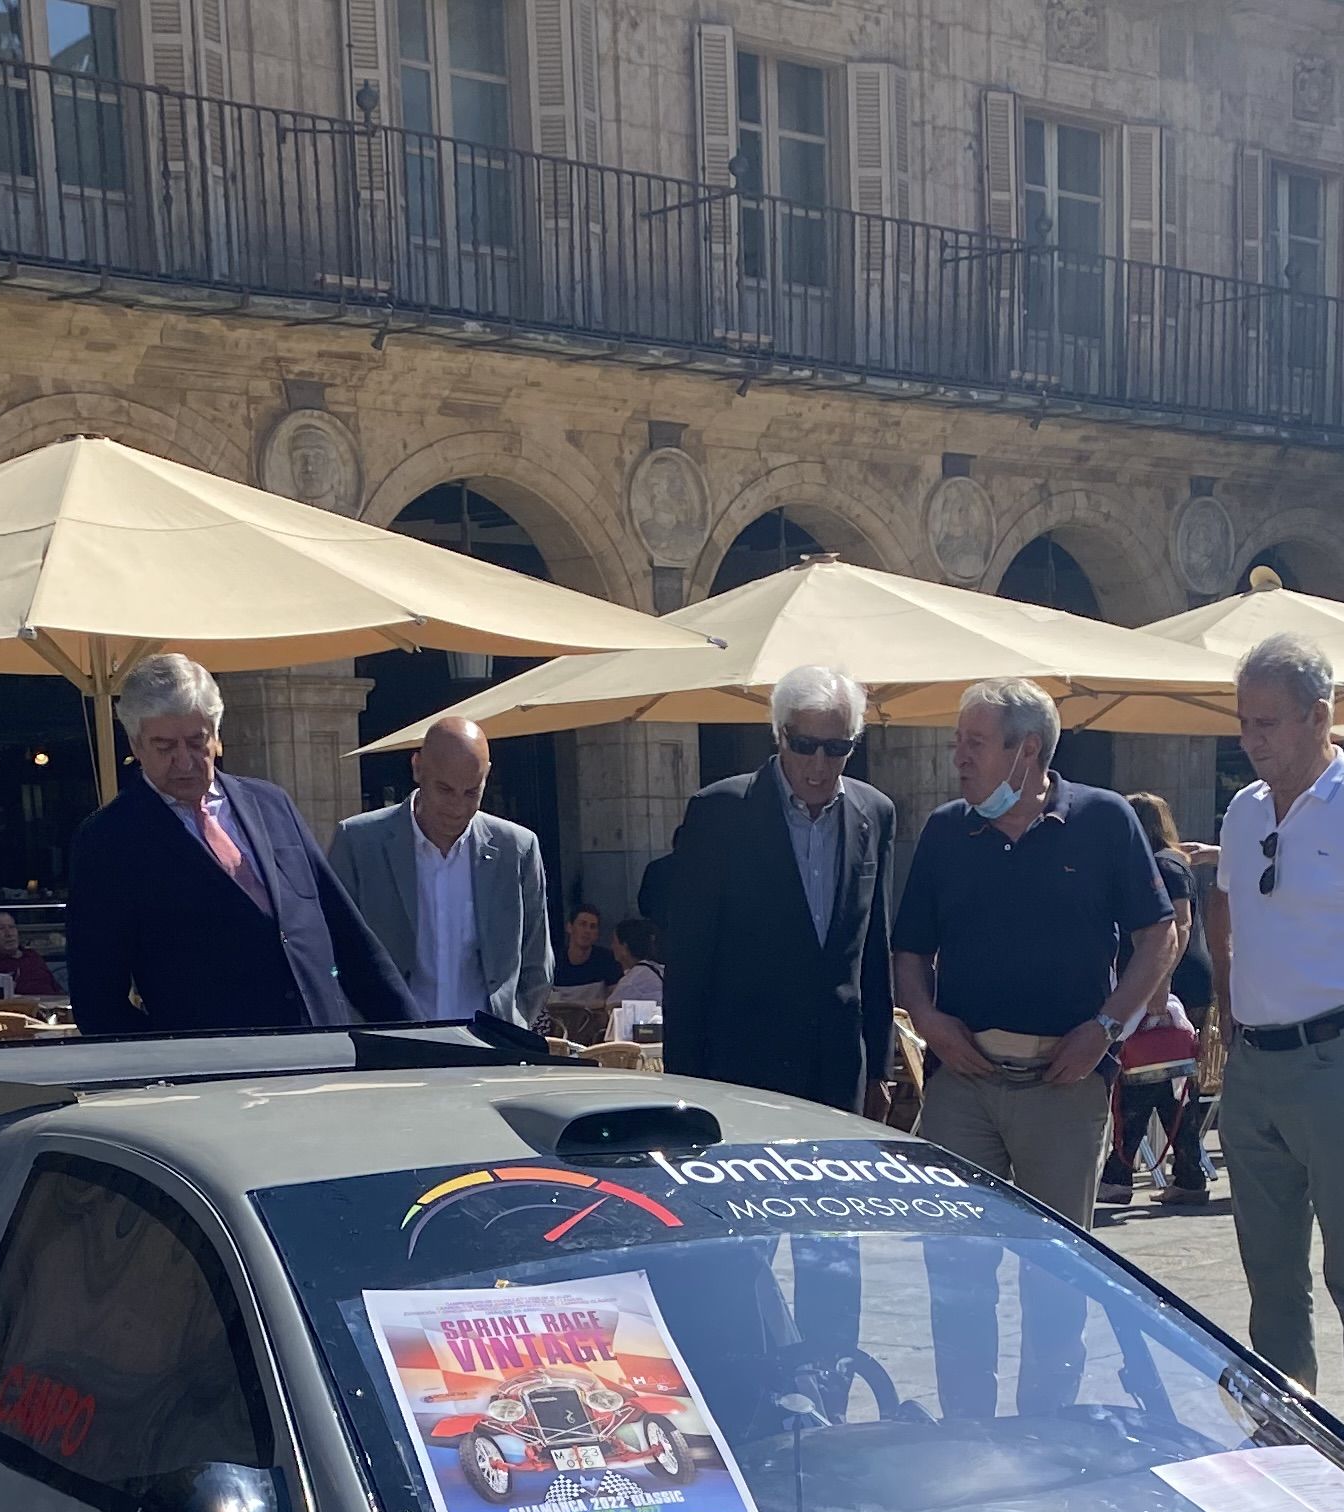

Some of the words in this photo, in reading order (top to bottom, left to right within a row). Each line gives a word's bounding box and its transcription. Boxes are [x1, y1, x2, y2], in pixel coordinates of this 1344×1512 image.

[649, 1146, 970, 1188] lombardia
[727, 1196, 984, 1220] MOTORSPORT
[440, 1313, 532, 1341] SPRINT
[540, 1309, 606, 1334] RACE
[446, 1331, 618, 1373] VINTAGE
[590, 1494, 628, 1511] 2022
[632, 1489, 686, 1507] CLASSIC
